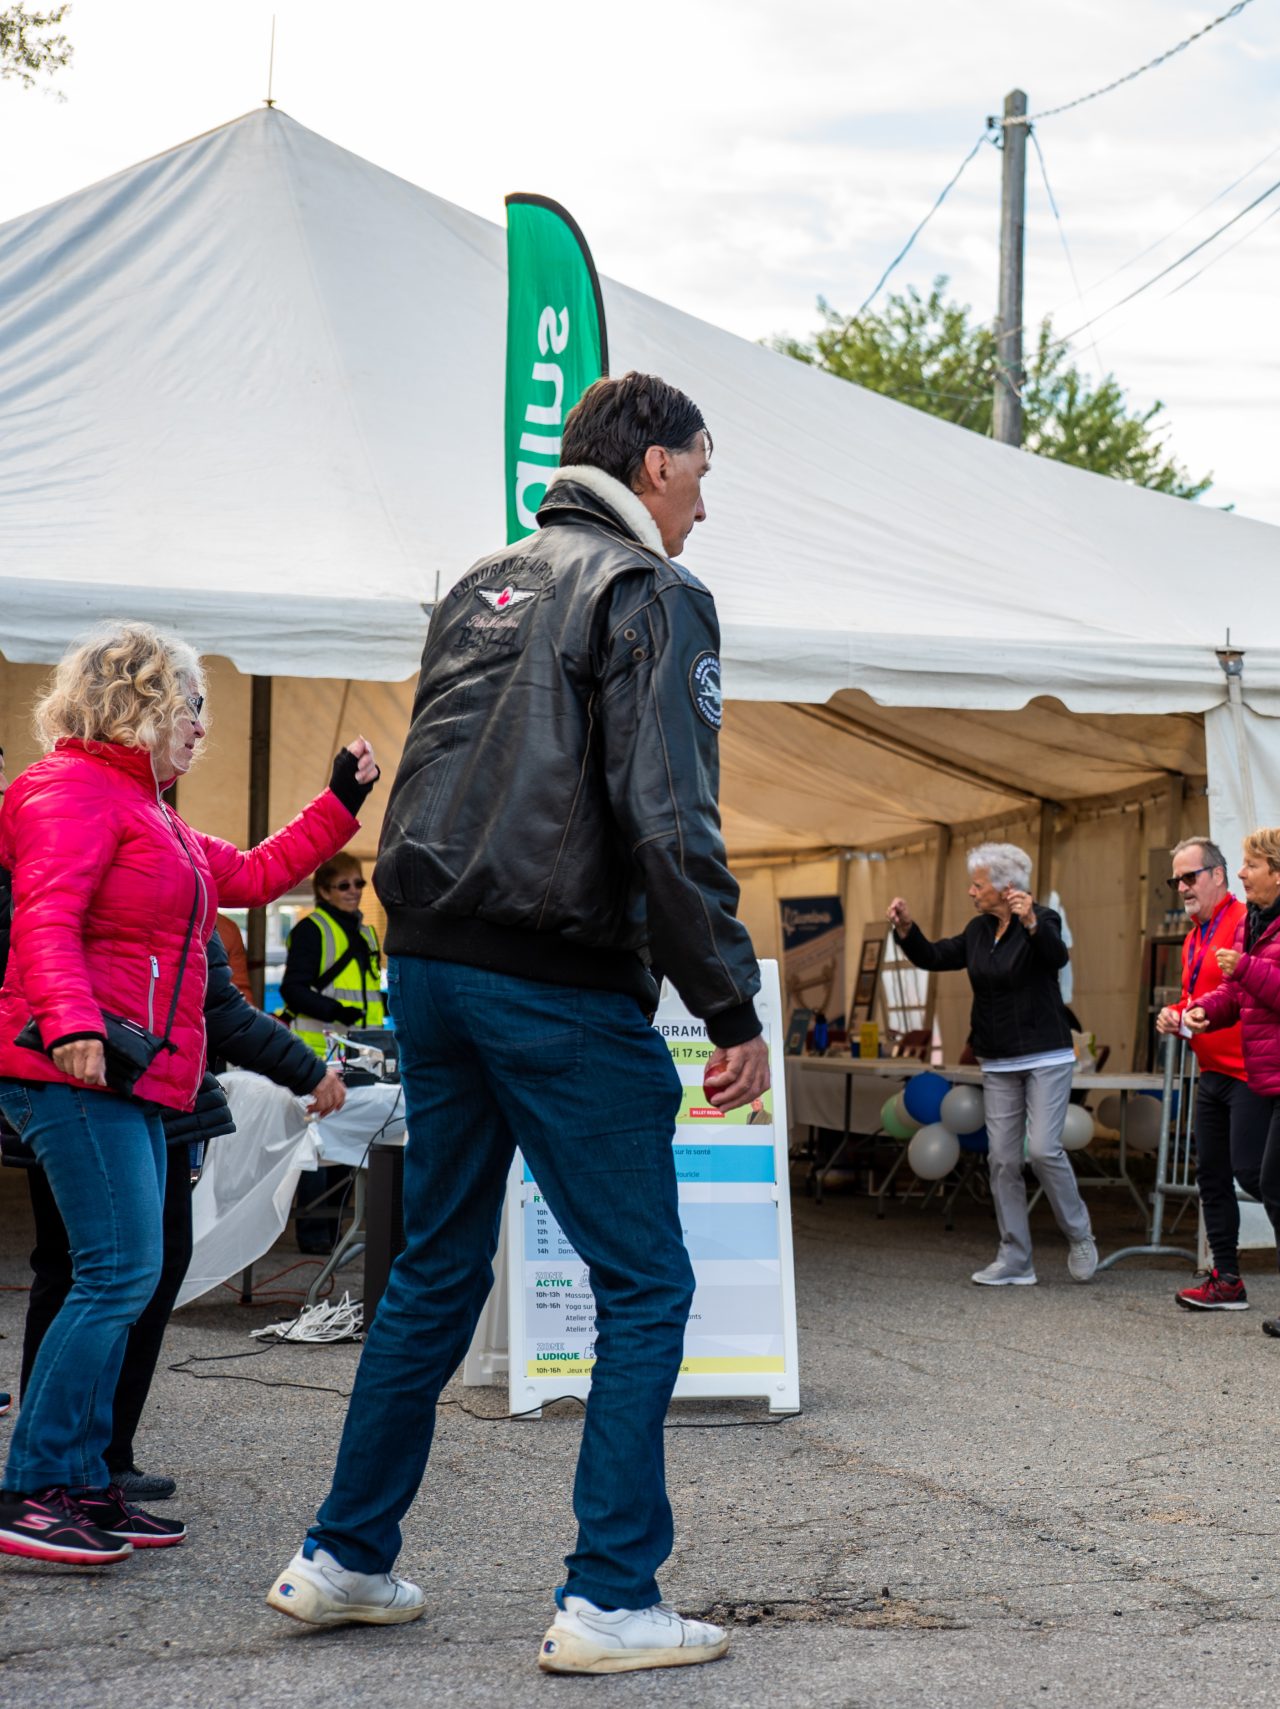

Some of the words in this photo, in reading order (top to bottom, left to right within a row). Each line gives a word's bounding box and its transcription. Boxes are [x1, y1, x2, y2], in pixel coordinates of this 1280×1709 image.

[683, 1048, 693, 1058] 17
[565, 1303, 581, 1311] Yoga
[536, 1352, 580, 1361] LUDIQUE
